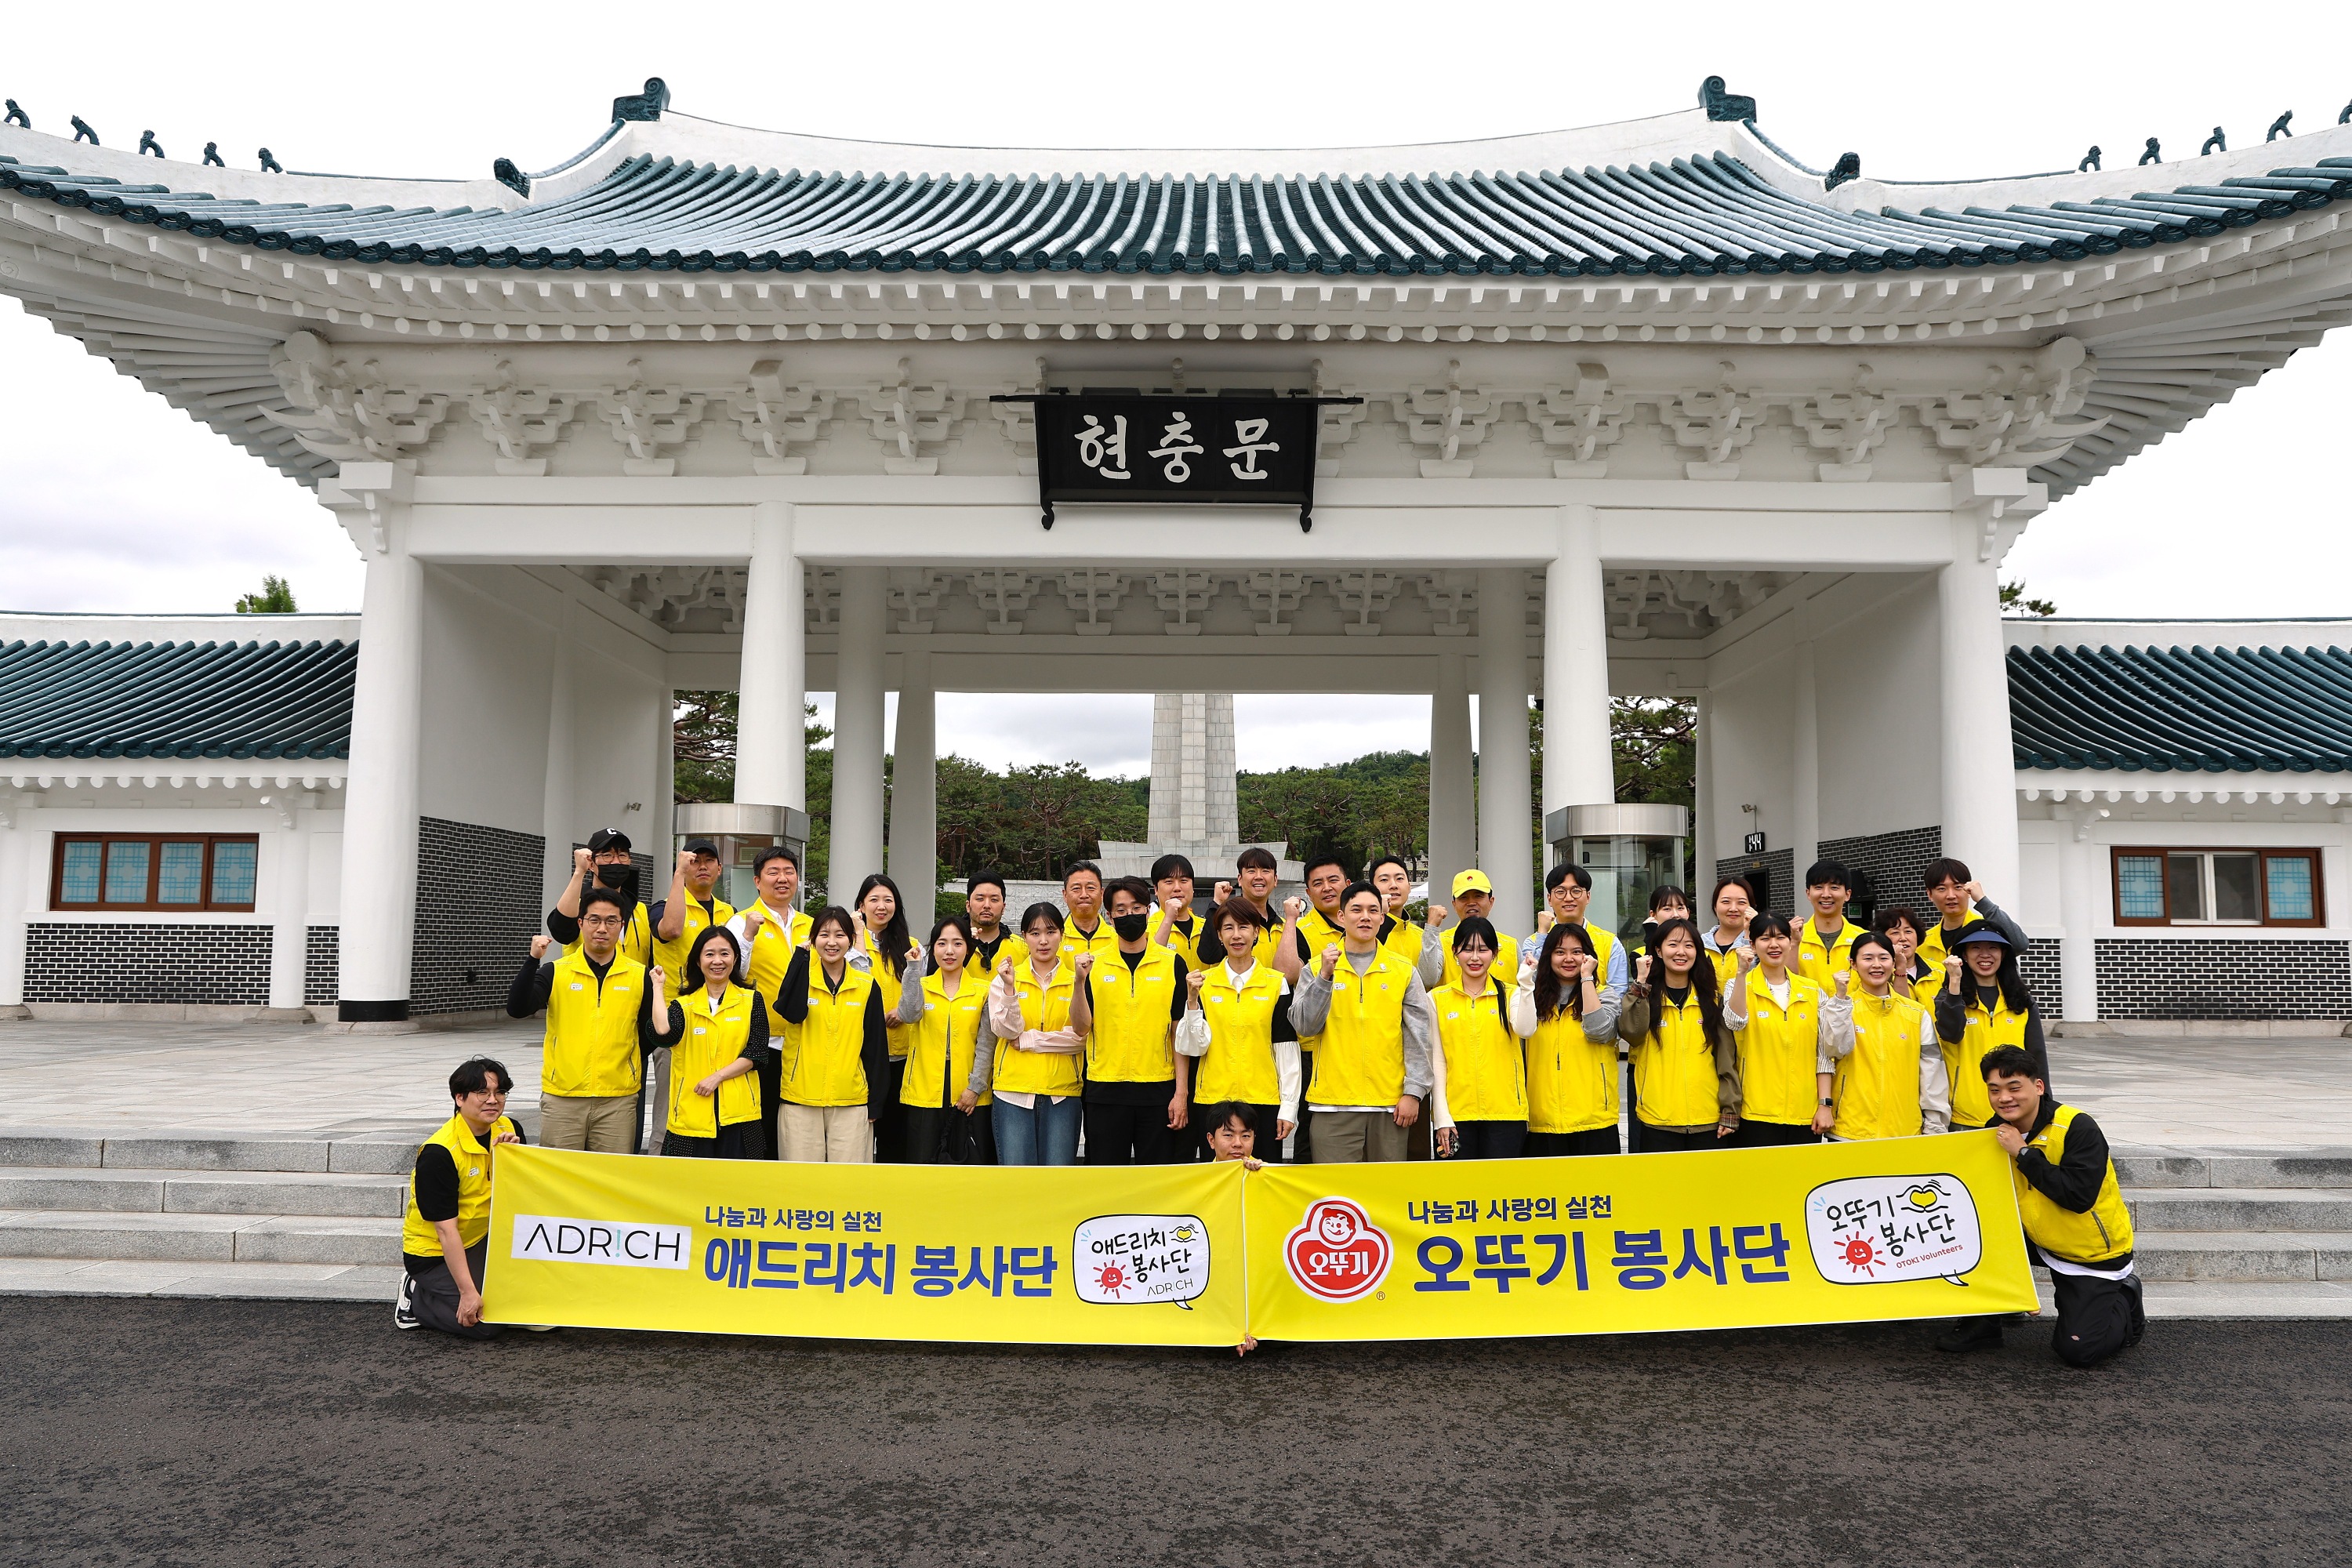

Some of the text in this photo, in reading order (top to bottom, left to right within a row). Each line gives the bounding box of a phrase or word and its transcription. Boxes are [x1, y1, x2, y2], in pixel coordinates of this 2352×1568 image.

[1075, 412, 1279, 482] 현충문
[706, 1207, 880, 1232] 나눔과 사랑의 실천
[1409, 1196, 1612, 1224] 나눔과 사랑의 실천
[1828, 1196, 1894, 1232] 오뚜기
[1092, 1228, 1165, 1254] 애드리치
[1880, 1213, 1955, 1257] 봉사단
[706, 1239, 1057, 1297] 애드리치 봉사단
[1133, 1249, 1192, 1283] 봉사단
[1309, 1251, 1370, 1276] 오뚜기
[1415, 1222, 1790, 1292] 오뚜기 봉사단
[1896, 1243, 1963, 1269] OTOKI Volunteers
